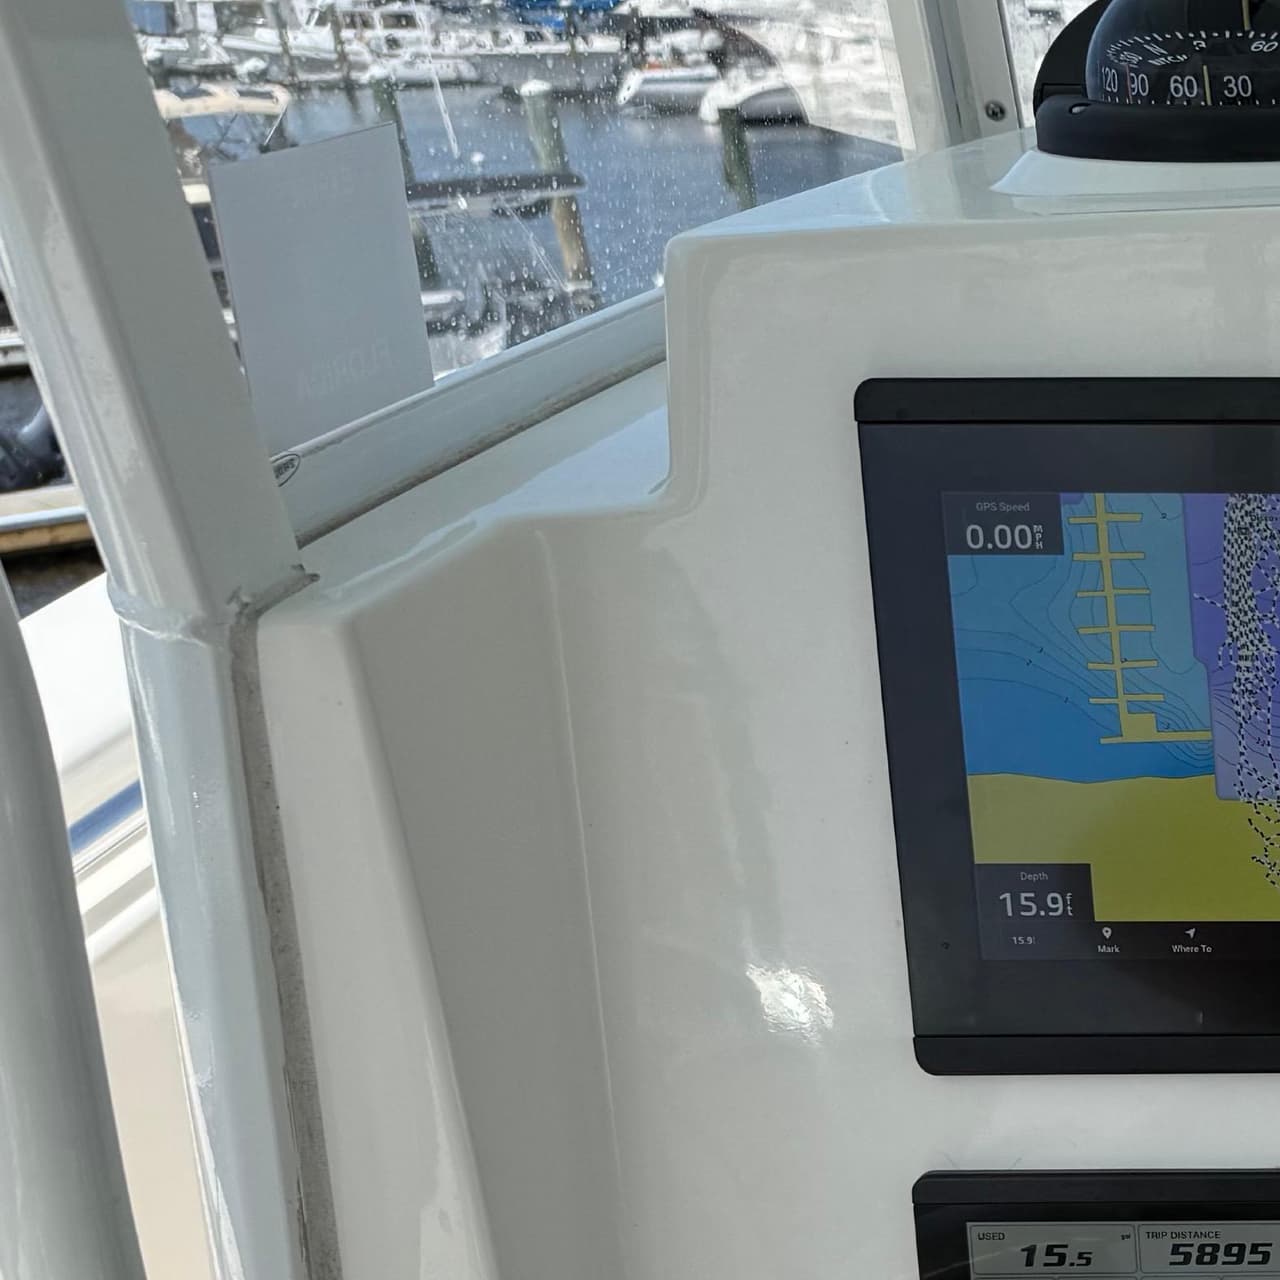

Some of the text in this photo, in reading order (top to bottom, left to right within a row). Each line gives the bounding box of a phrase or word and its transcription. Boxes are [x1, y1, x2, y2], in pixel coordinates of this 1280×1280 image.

[1170, 75, 1197, 98] 60
[1223, 75, 1252, 98] 30
[976, 502, 1029, 513] GPS Speed
[966, 524, 1032, 549] 0.00
[1020, 872, 1048, 881] Depth
[1172, 945, 1212, 953] Where To
[977, 1232, 1005, 1241] USED
[1146, 1231, 1221, 1240] TRIP DISTANCE
[1020, 1244, 1093, 1267] 15.5
[1169, 1243, 1272, 1266] 5895
